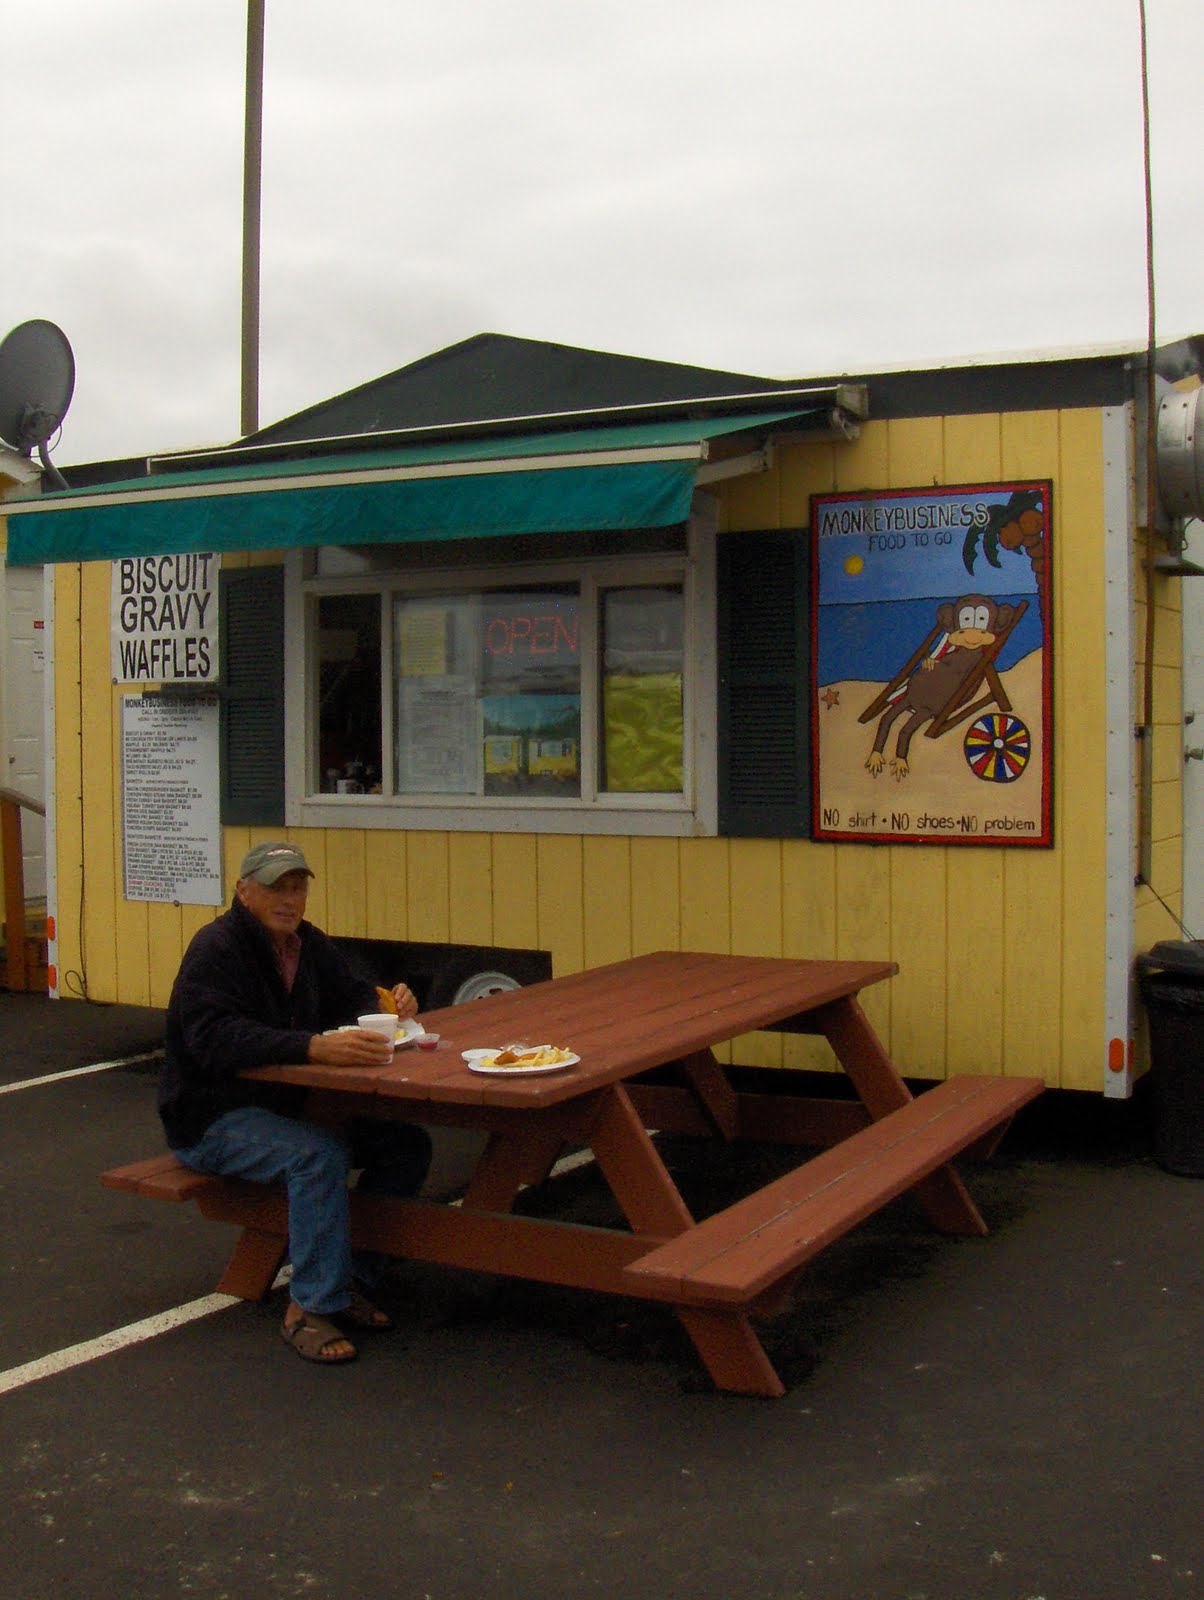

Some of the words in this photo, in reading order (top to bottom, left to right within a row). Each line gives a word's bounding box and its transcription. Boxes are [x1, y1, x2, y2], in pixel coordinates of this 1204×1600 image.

[822, 503, 991, 536] MONKEYBUSINESS
[869, 533, 906, 552] FOOD
[911, 532, 929, 547] TO
[934, 531, 953, 546] GO
[120, 552, 213, 595] BISCUIT
[120, 592, 211, 633] GRAVY
[486, 614, 580, 657] OPEN
[120, 636, 211, 680] WAFFLES
[823, 809, 840, 827] NO
[849, 812, 876, 828] shirt
[891, 813, 910, 831] NO
[917, 813, 954, 829] shoes
[961, 816, 978, 832] NO
[984, 818, 1035, 834] problem
